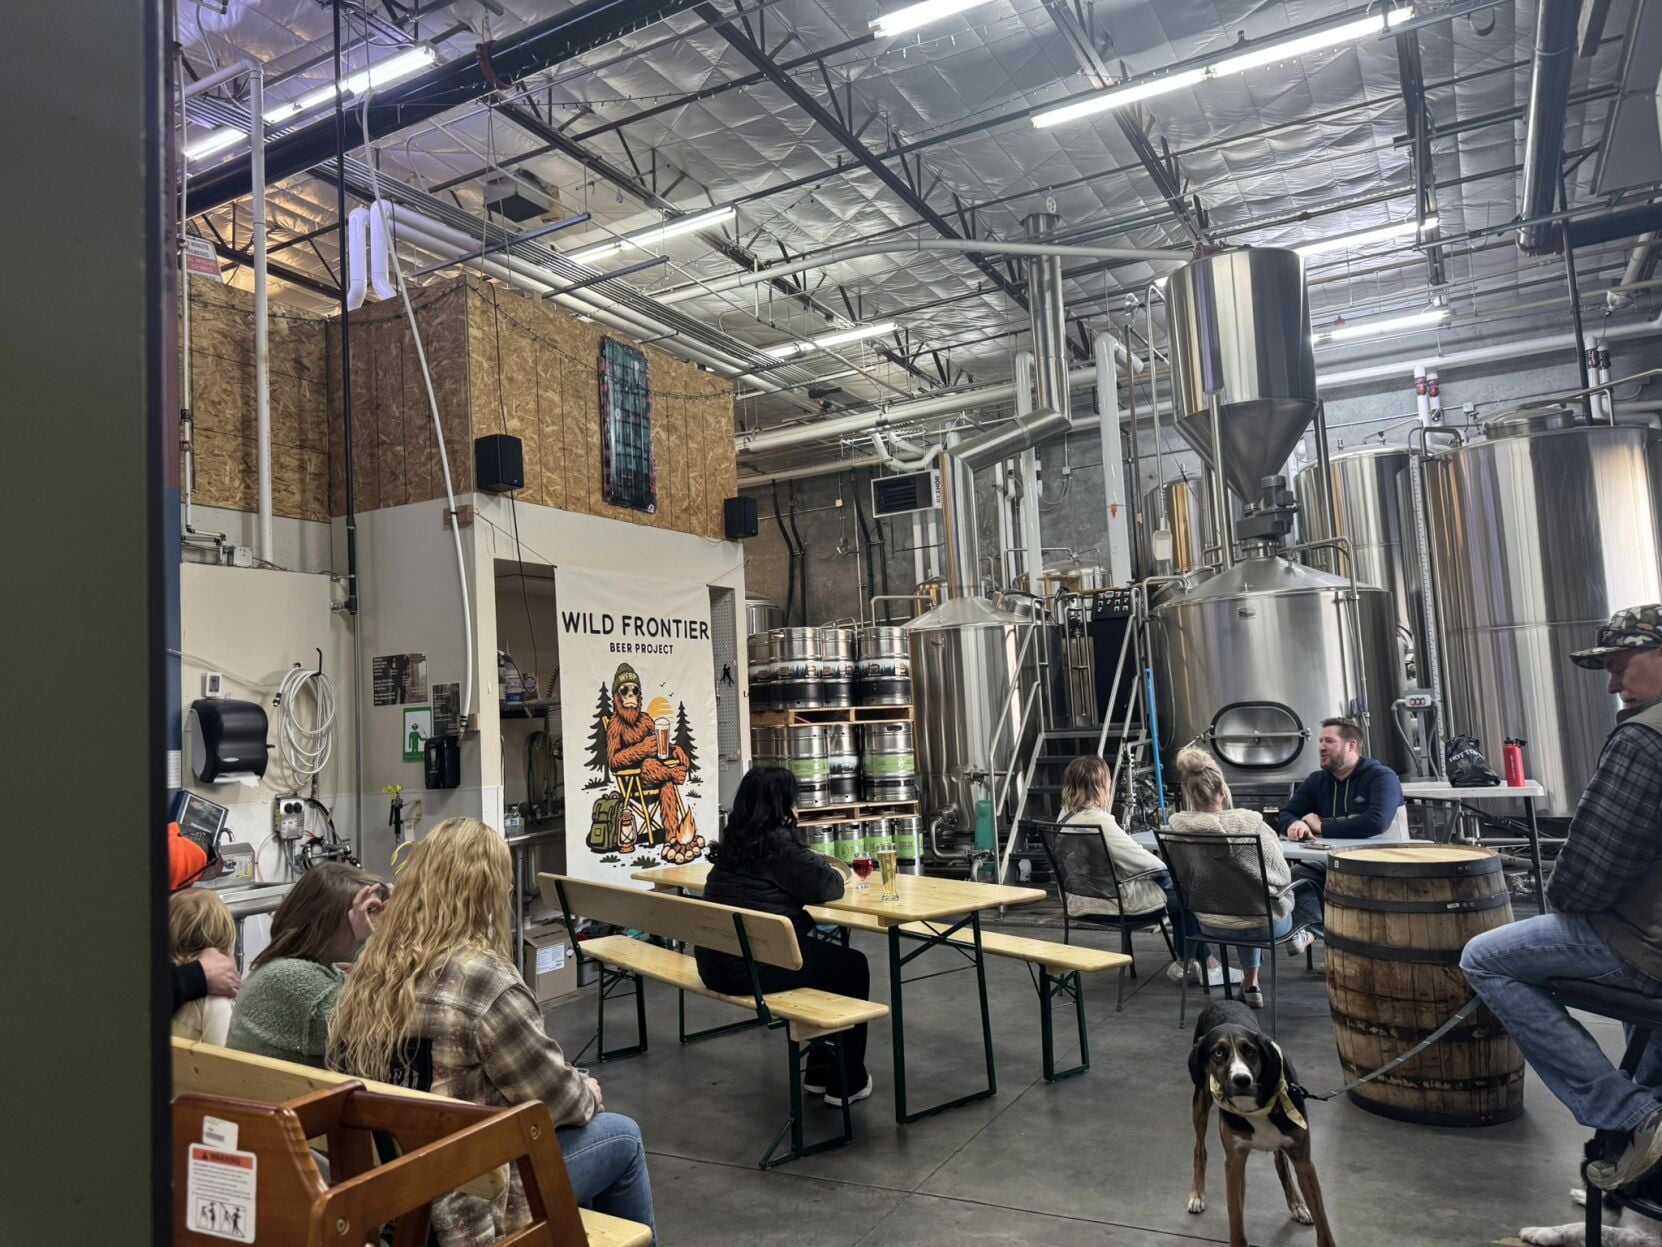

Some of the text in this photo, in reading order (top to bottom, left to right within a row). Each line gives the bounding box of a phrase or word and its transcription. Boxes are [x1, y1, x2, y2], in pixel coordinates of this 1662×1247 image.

[562, 611, 710, 640] WILD FRONTIER
[610, 642, 674, 655] BEER PROJECT
